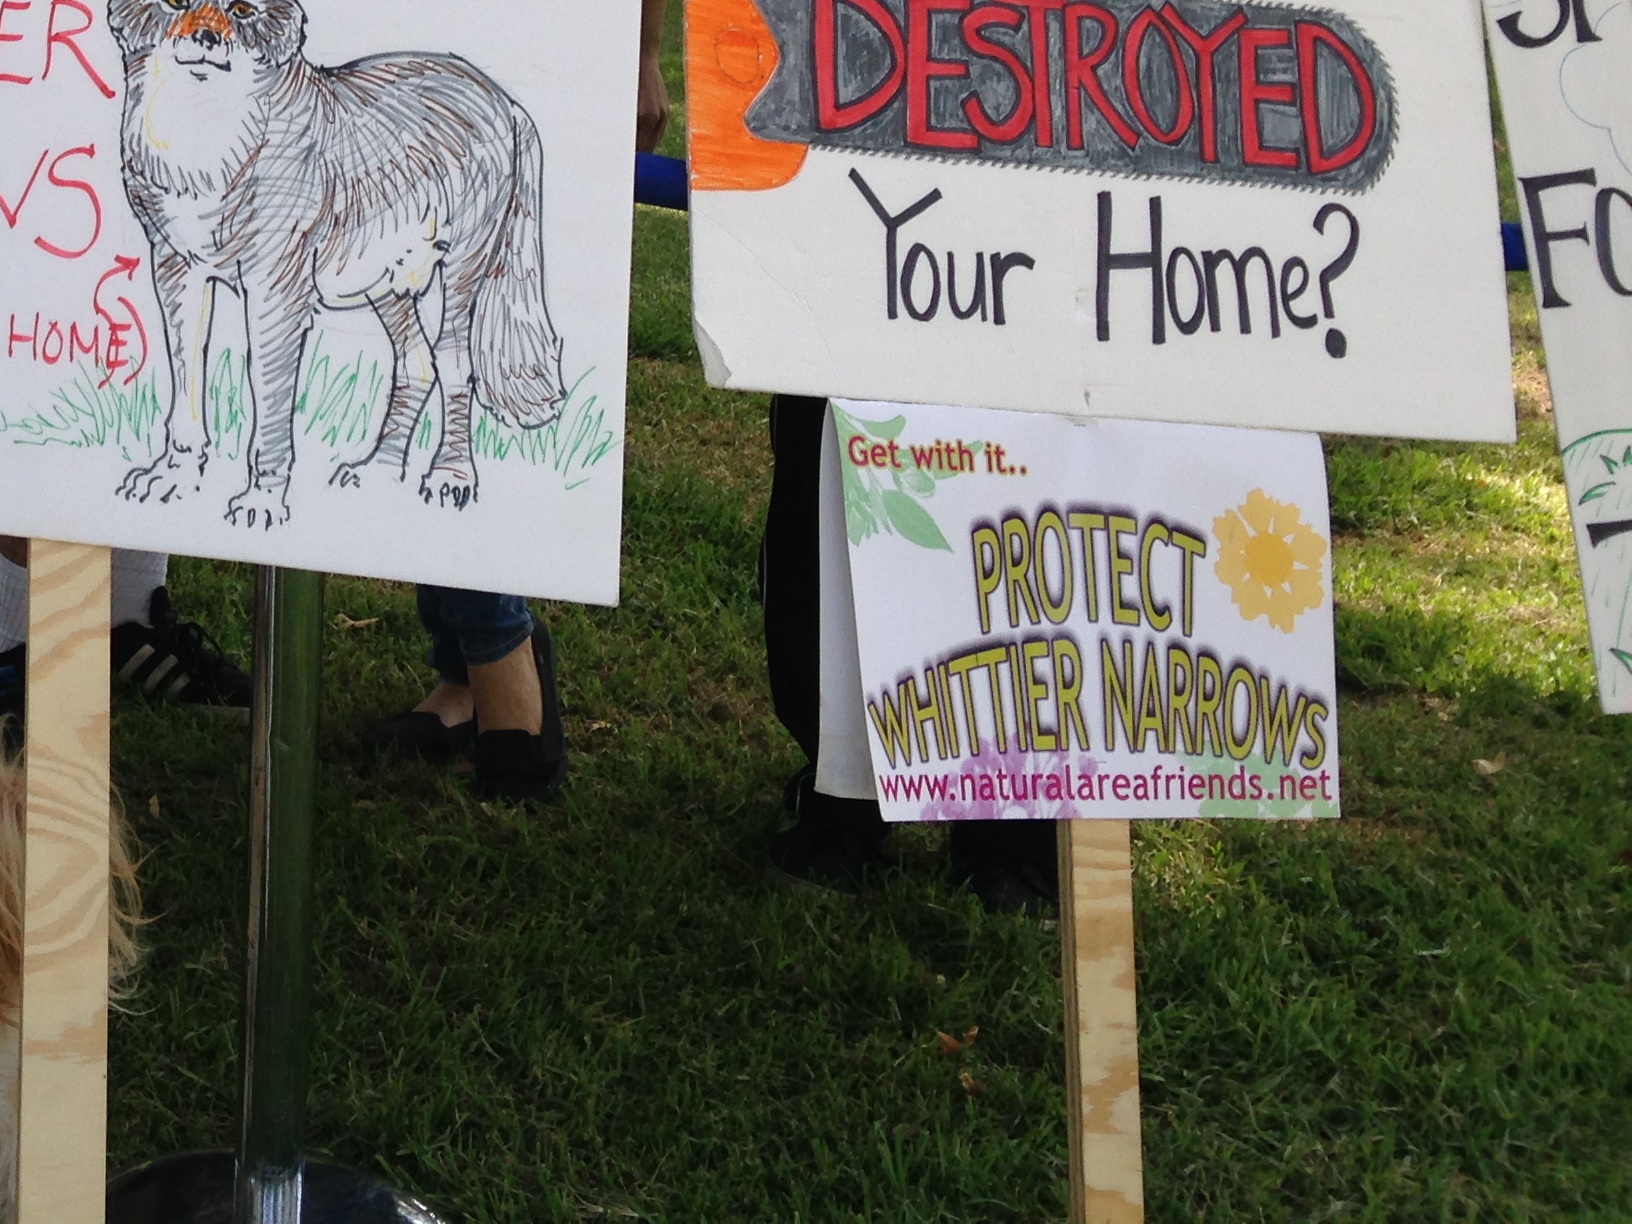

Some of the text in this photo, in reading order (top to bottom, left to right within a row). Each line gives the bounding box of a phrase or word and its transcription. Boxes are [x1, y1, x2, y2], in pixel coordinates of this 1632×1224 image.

[848, 167, 1361, 359] Your Home?
[7, 295, 149, 387] HOME)
[848, 435, 1028, 475] Get with it..
[972, 511, 1206, 637] PROTECT
[869, 638, 1328, 769] WHITTIER NARROWS
[879, 766, 1332, 802] www.naturalareafriends.net
